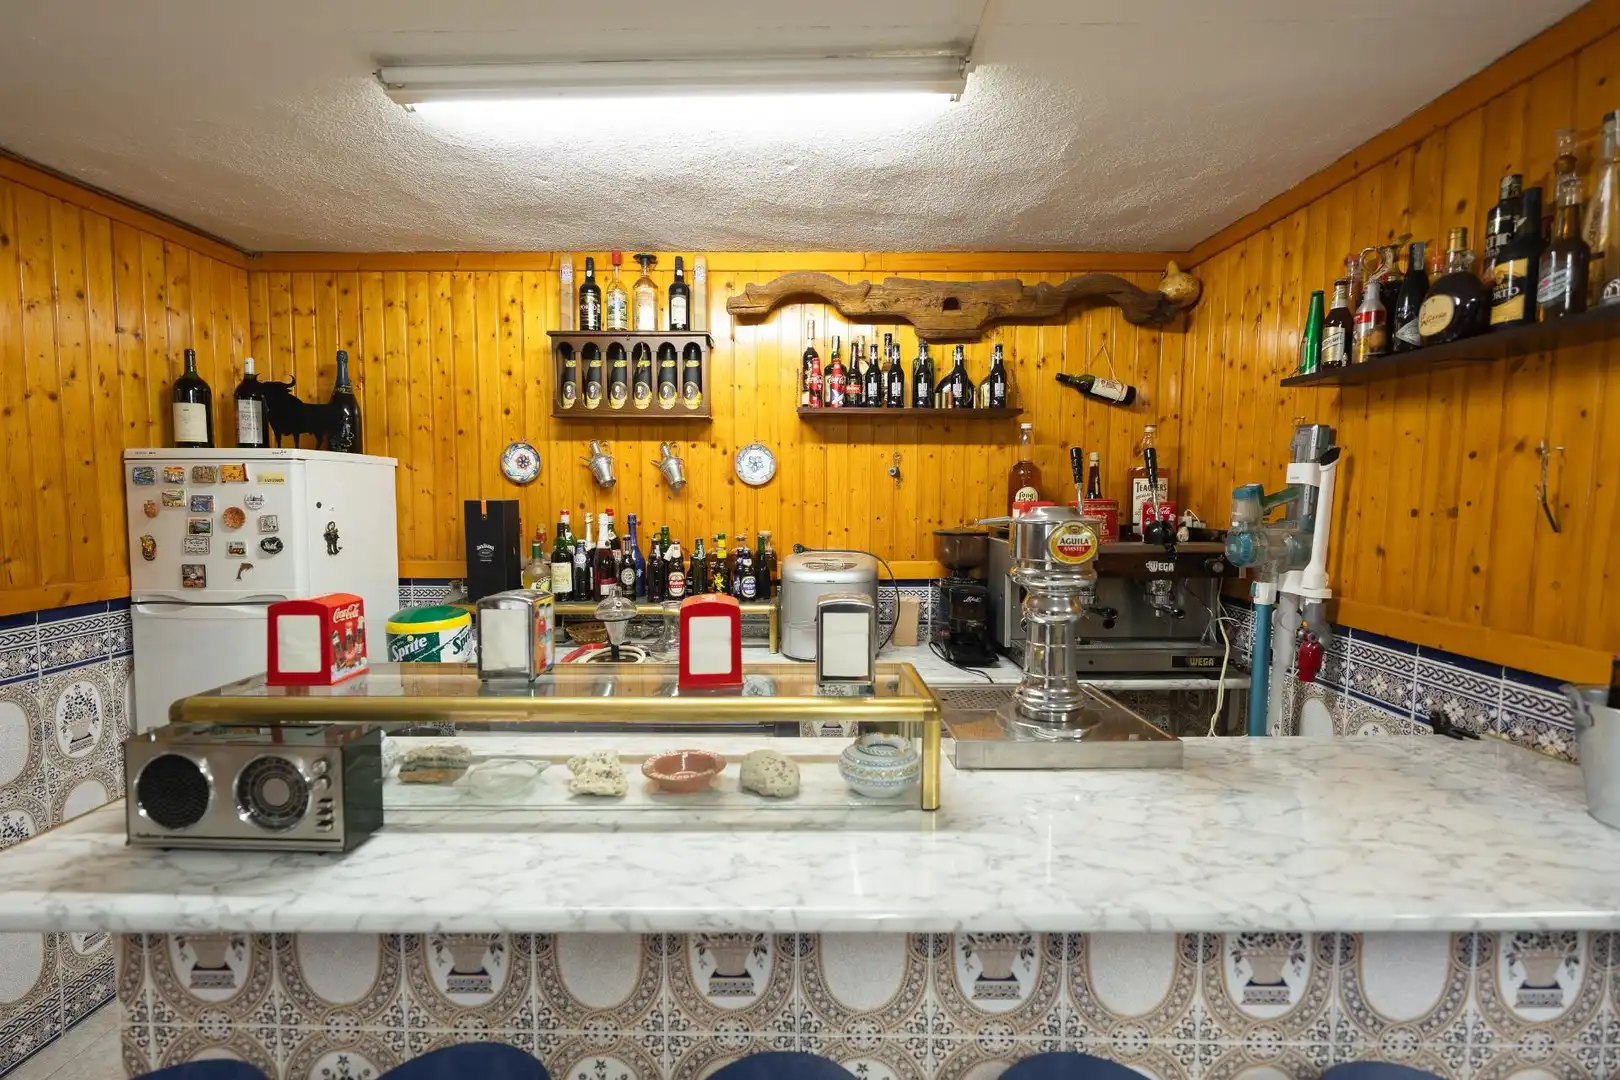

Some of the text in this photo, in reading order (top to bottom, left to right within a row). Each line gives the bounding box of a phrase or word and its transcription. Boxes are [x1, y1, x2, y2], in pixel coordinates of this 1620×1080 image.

[1059, 537, 1089, 545] AGUILA
[1150, 562, 1174, 572] WEGA
[333, 603, 360, 623] Coca-Cola
[392, 636, 428, 662] Sprite
[1189, 657, 1214, 666] WEGA
